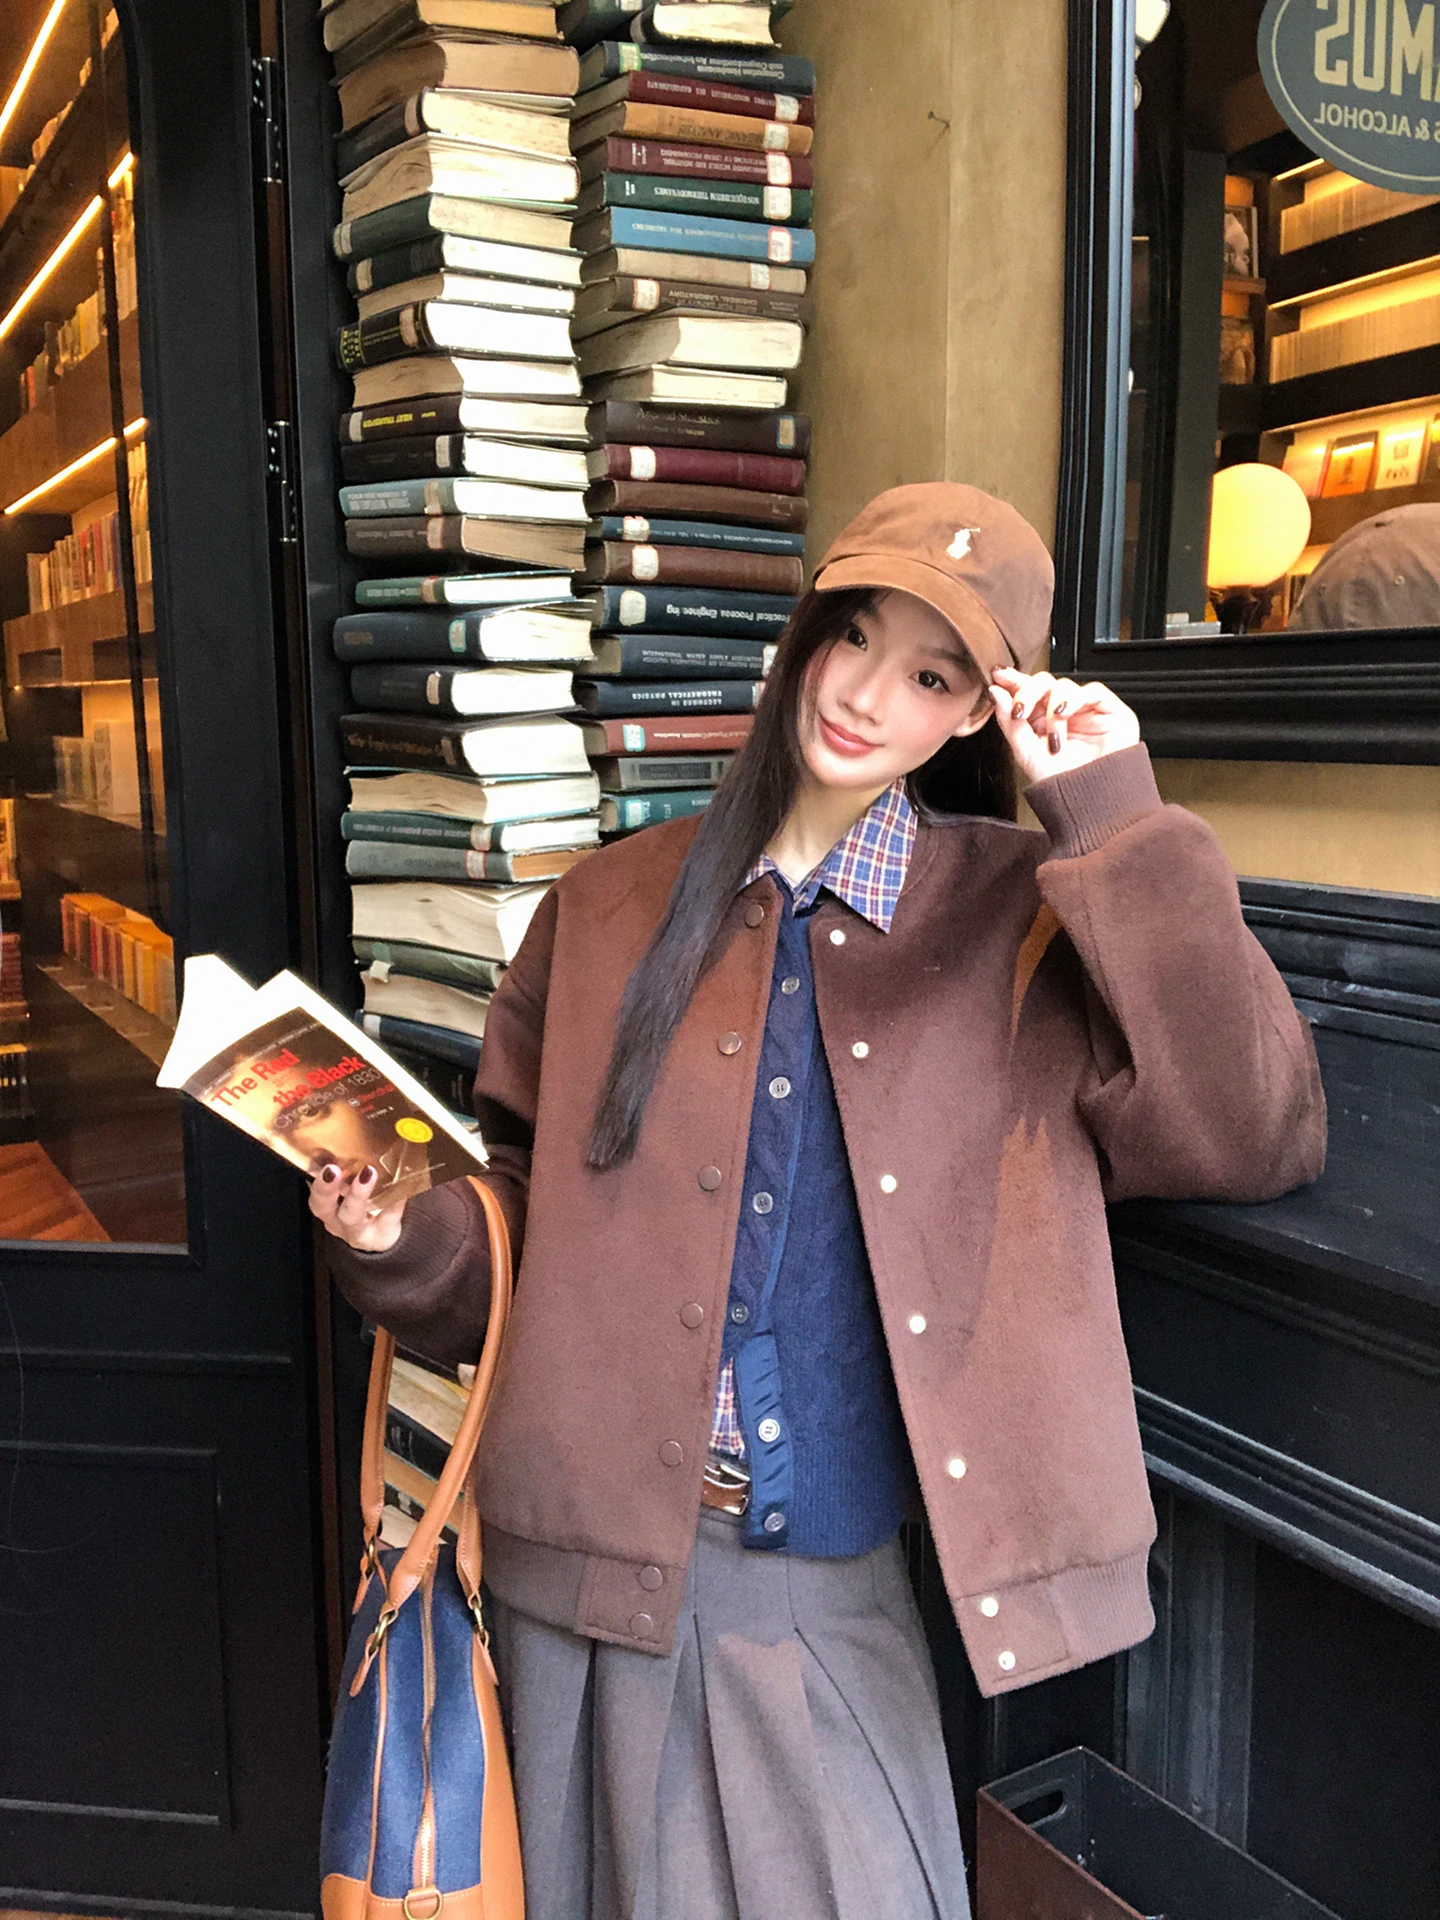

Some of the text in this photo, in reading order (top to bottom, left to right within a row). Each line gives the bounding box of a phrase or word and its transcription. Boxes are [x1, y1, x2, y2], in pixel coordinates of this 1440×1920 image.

[721, 608, 754, 621] Process
[756, 612, 791, 623] Practical
[632, 689, 722, 699] THEORETICAL PHYSICS
[670, 698, 722, 707] LECTURES IN
[210, 1077, 258, 1107] The
[250, 1047, 300, 1081] Red
[273, 1055, 367, 1108] the Black
[333, 1082, 349, 1096] of
[347, 1067, 382, 1086] 1830
